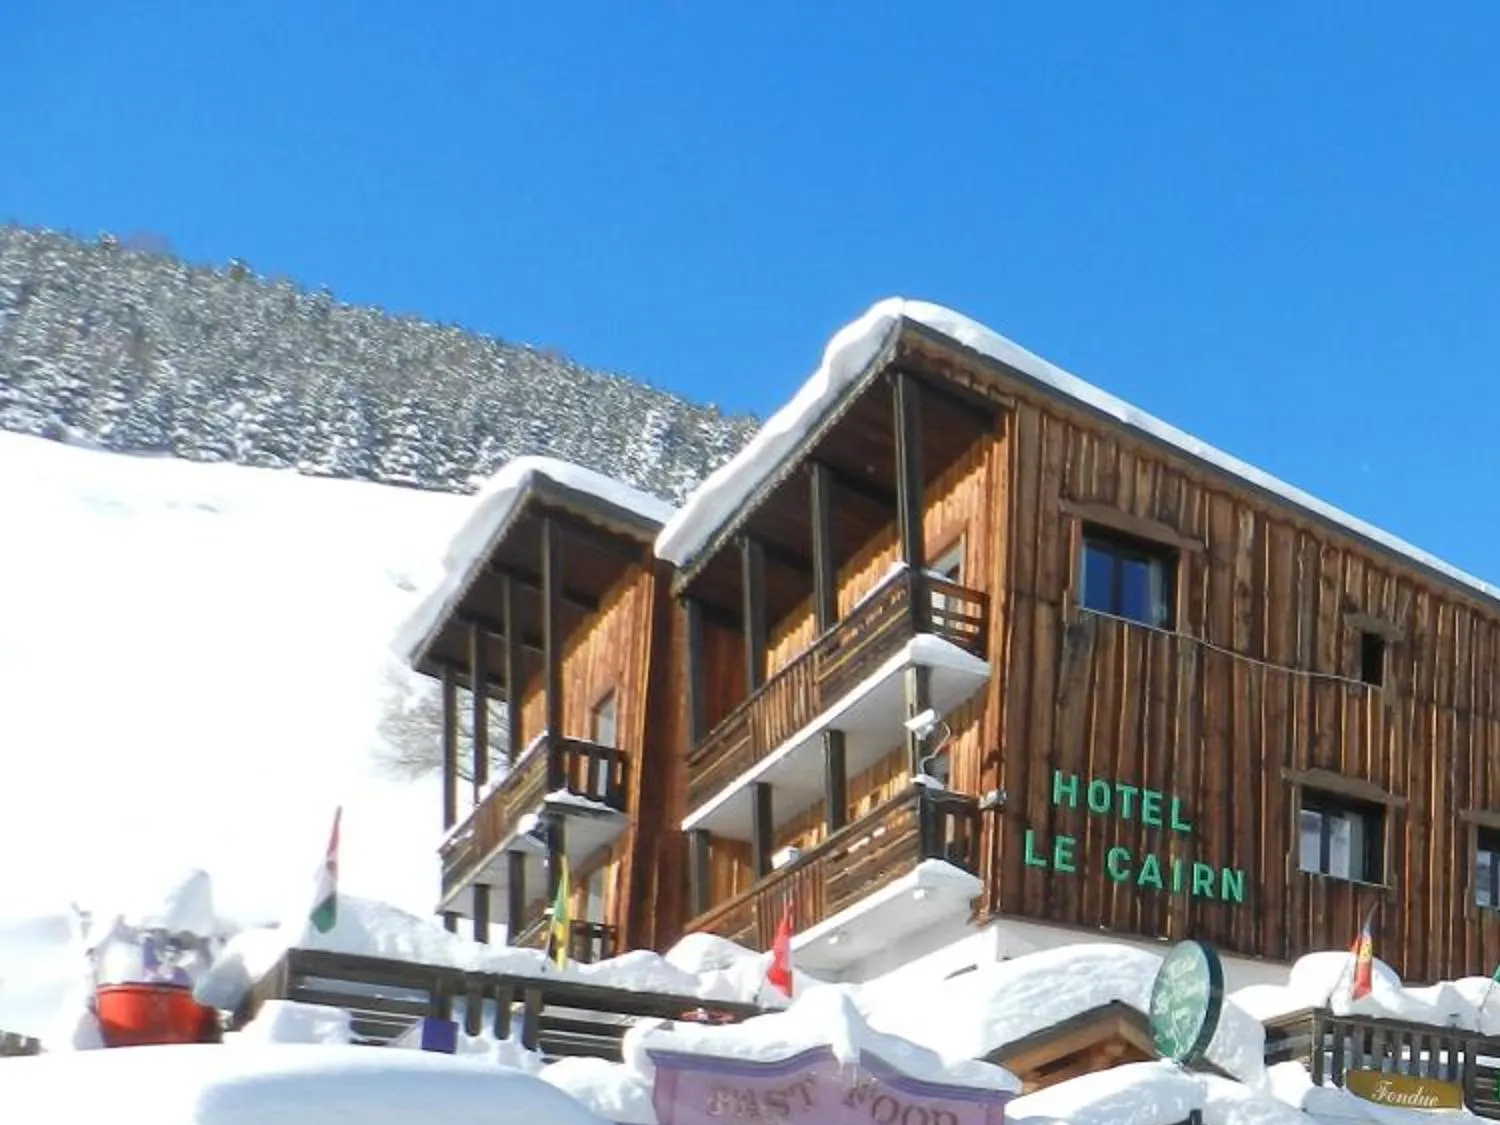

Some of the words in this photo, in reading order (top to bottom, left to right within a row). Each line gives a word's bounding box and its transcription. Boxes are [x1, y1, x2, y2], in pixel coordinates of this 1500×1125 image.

[1053, 769, 1192, 832] HOTEL
[1024, 829, 1077, 873] LE
[1106, 847, 1244, 903] CAIRN
[707, 1075, 816, 1118] FAST
[1372, 1080, 1440, 1107] Fondue
